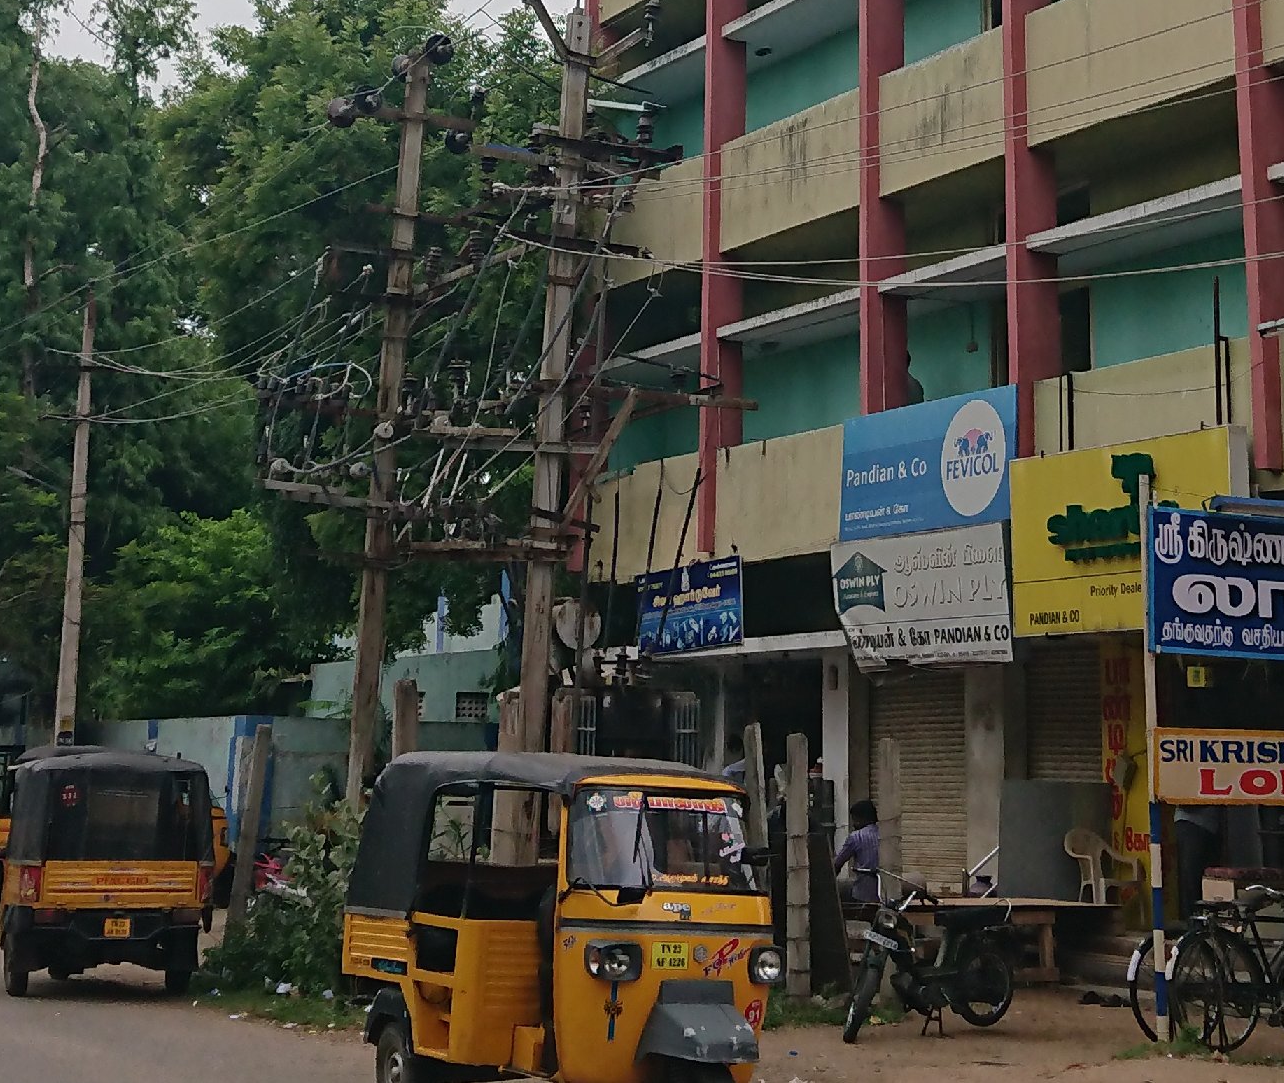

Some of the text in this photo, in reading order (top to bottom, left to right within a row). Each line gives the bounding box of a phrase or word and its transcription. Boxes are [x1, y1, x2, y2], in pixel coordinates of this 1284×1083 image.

[846, 457, 928, 488] Pandian & Co
[946, 452, 1000, 482] FEVICOL
[866, 573, 880, 587] PLY
[1090, 581, 1142, 599] Priority Deale
[1029, 611, 1062, 627] PANDIAN
[1069, 609, 1081, 624] CO
[897, 627, 908, 646] &
[933, 624, 982, 645] PANDIAN
[994, 624, 1011, 642] CO
[1159, 738, 1194, 764] SRI
